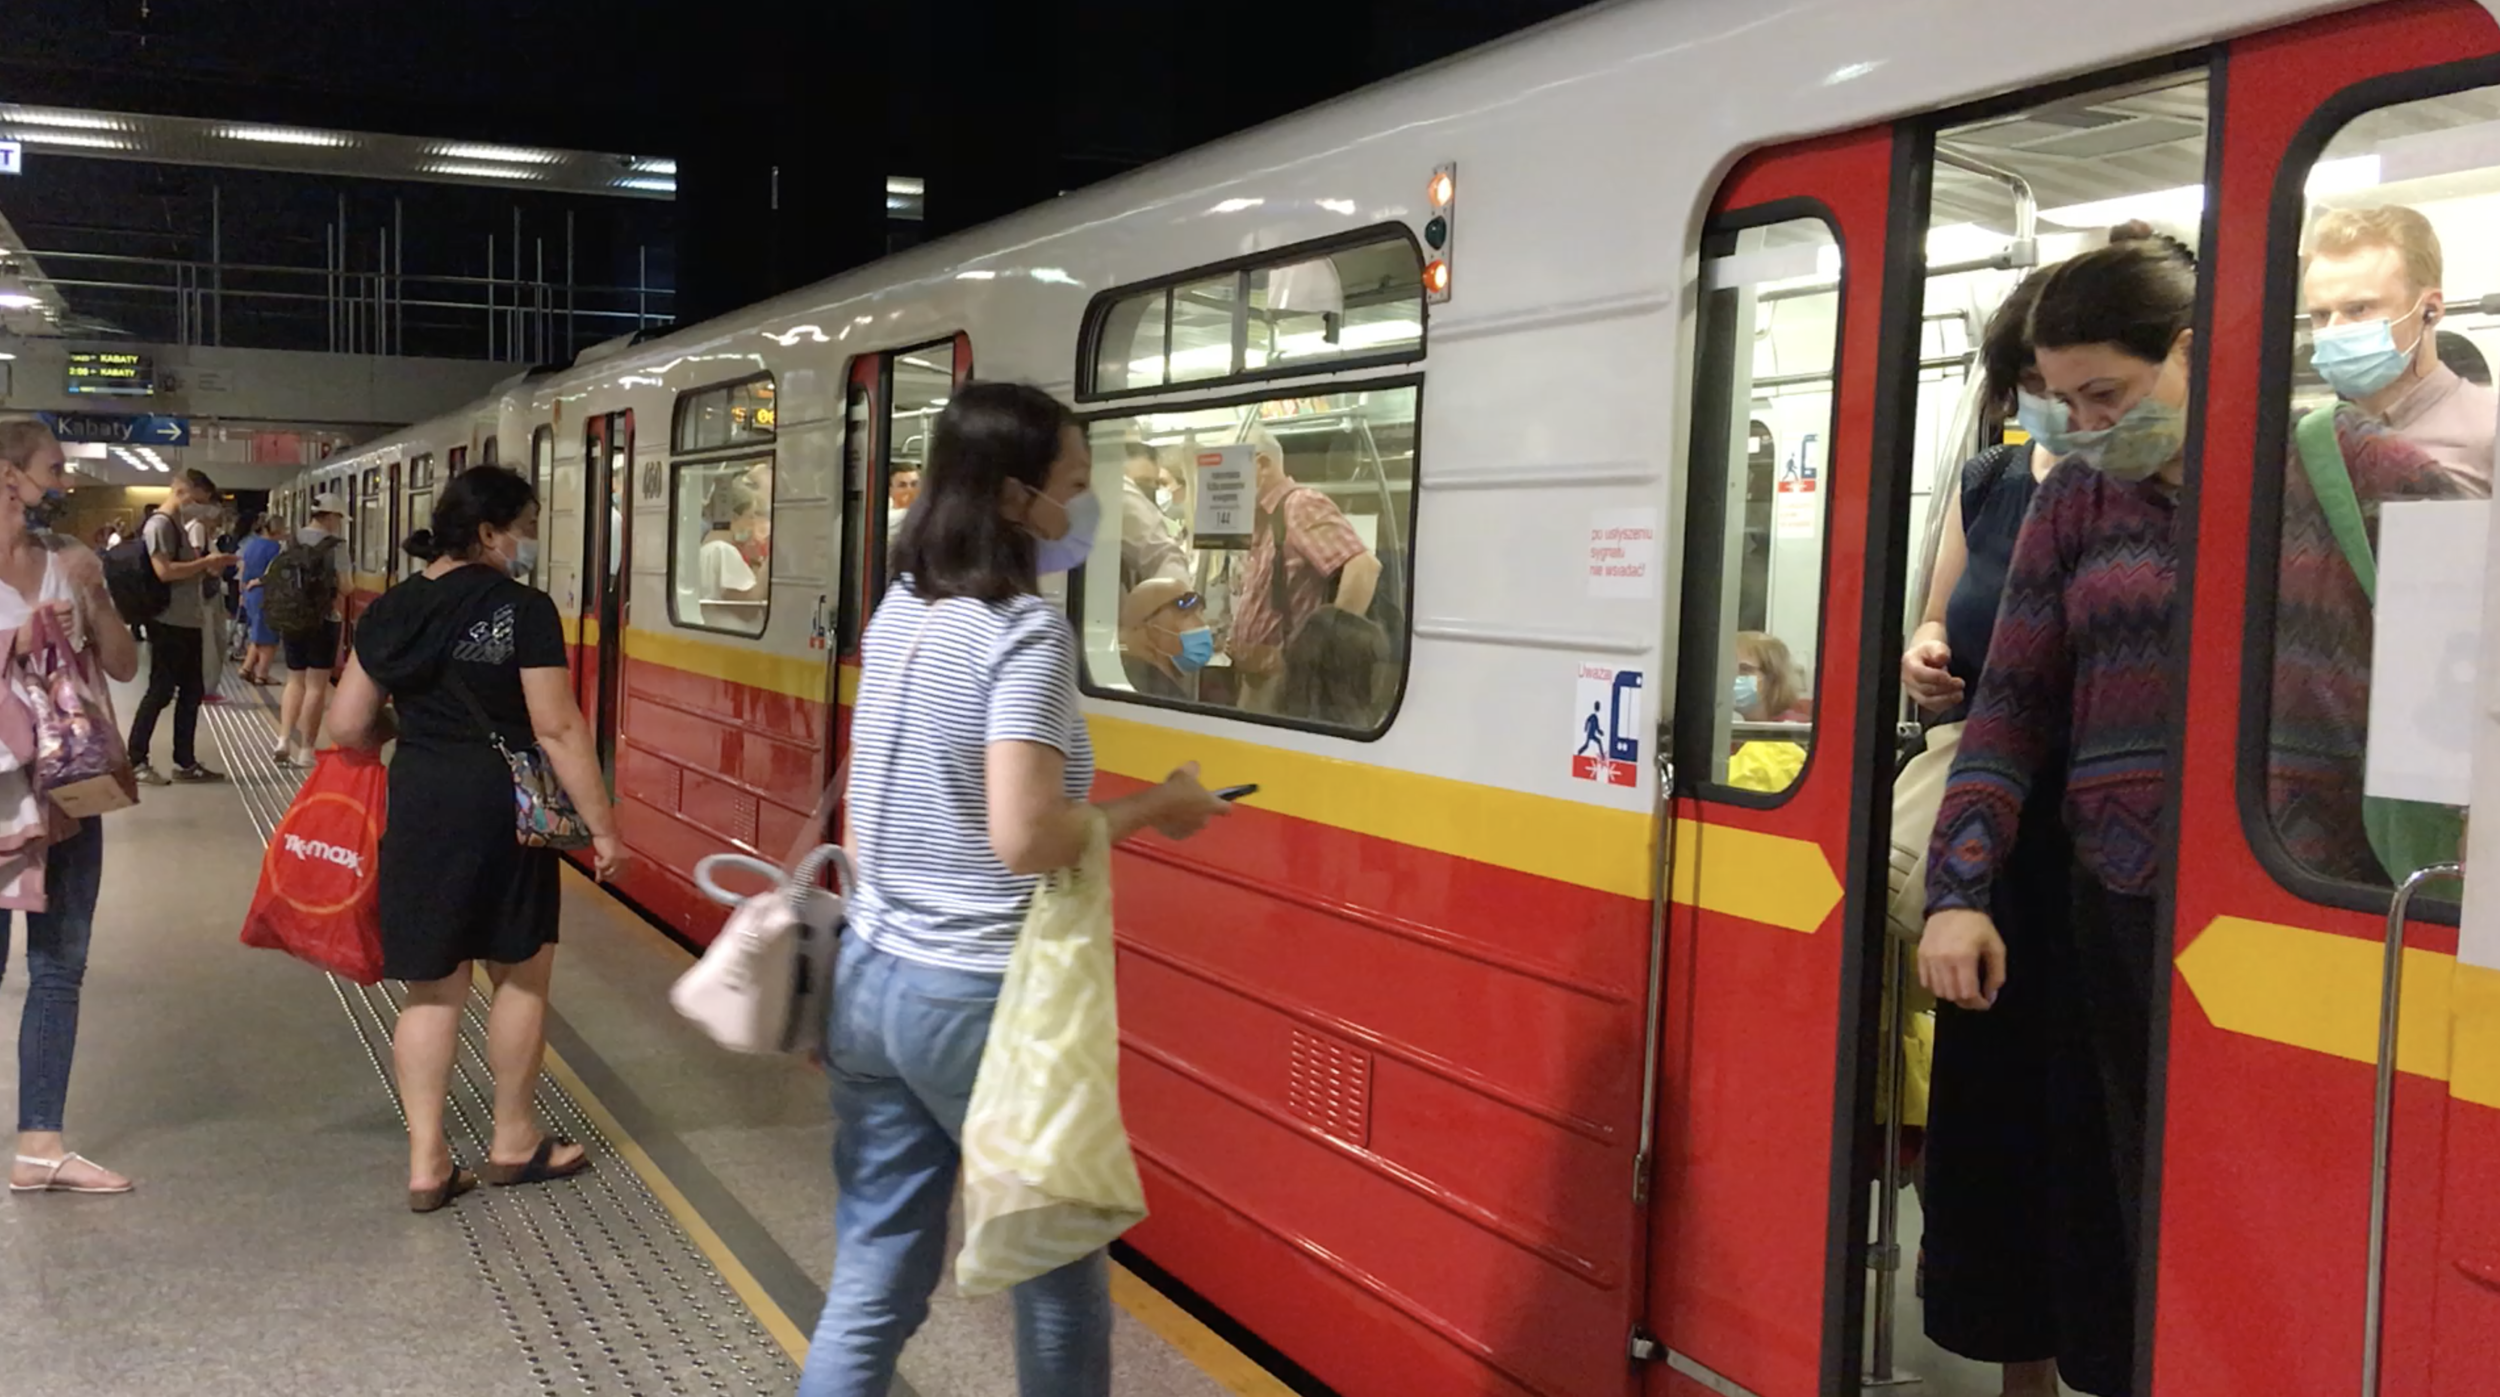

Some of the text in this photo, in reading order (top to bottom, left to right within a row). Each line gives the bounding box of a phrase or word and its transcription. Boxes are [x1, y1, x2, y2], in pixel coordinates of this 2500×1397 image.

[100, 354, 138, 364] KABATY
[100, 368, 136, 378] KABATY
[58, 416, 134, 441] Kabaty
